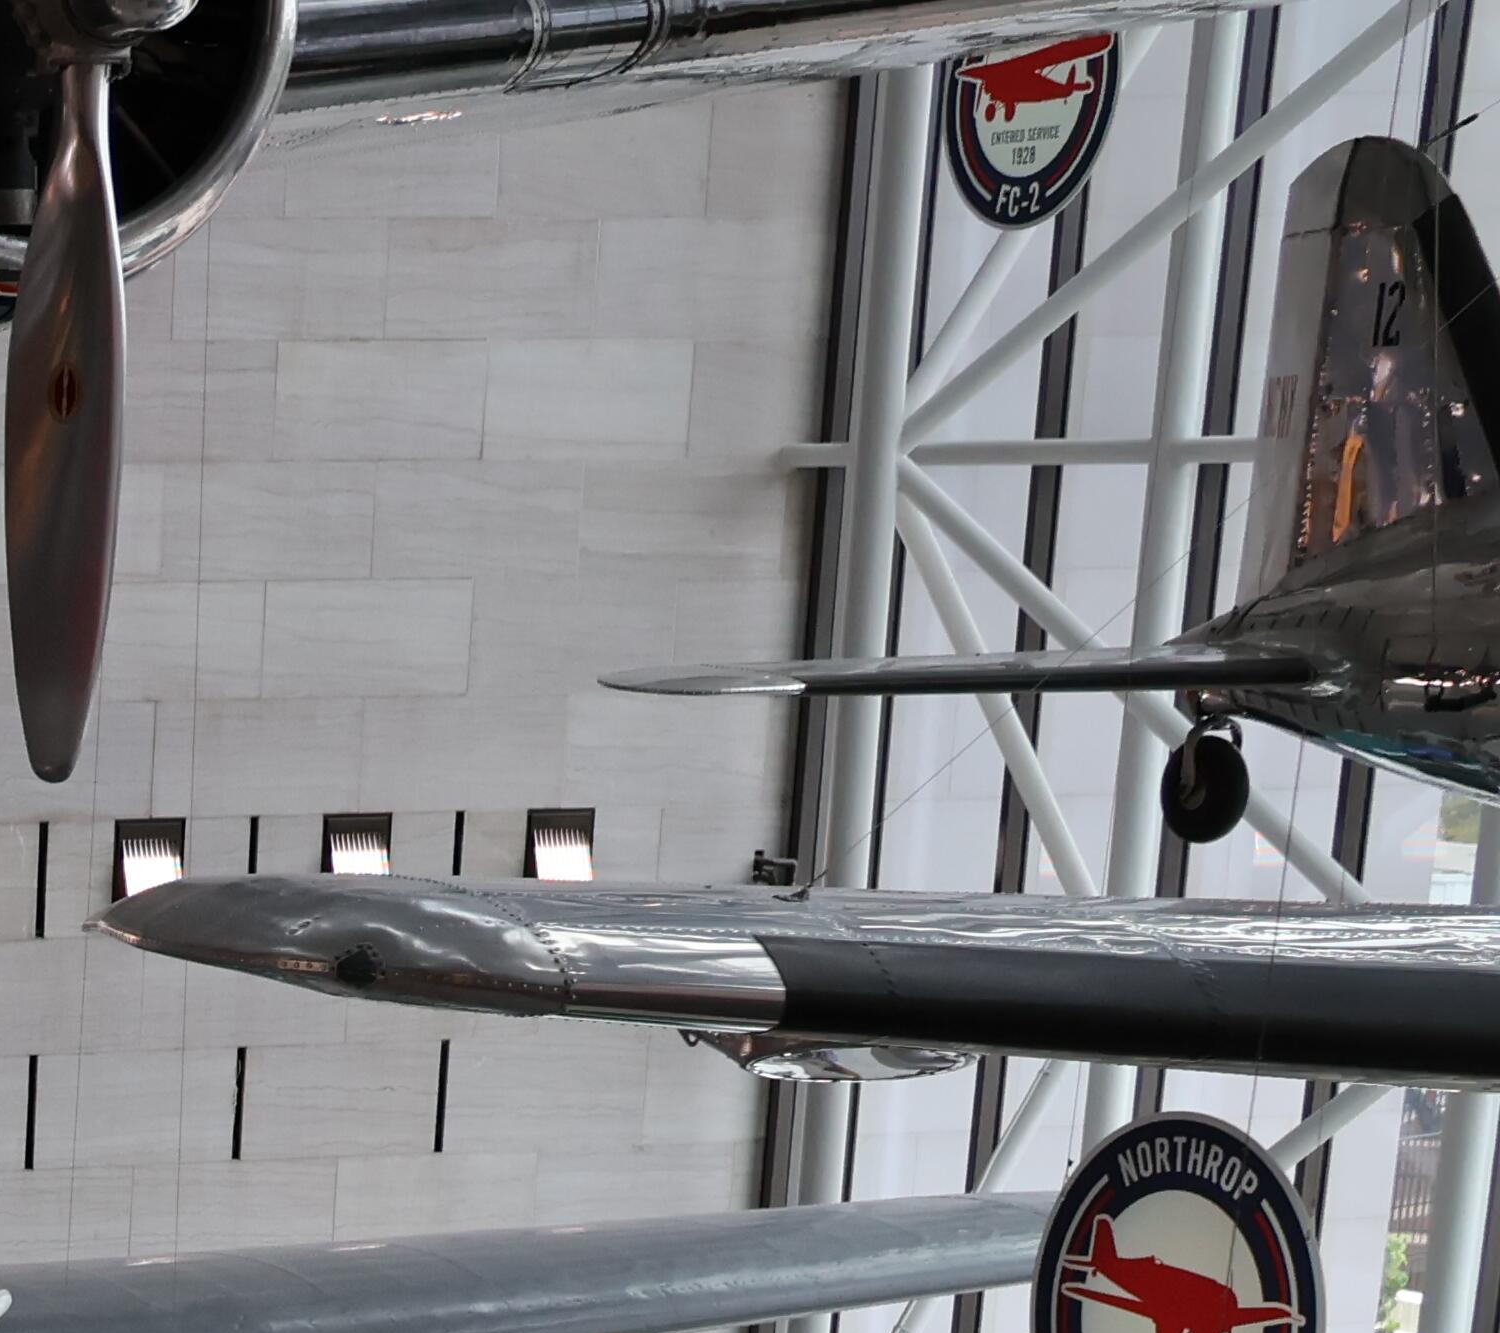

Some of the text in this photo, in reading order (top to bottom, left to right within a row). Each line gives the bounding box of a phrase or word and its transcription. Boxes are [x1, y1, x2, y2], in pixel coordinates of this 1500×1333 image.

[990, 125, 1060, 147] ENTERED SERVICE
[1011, 146, 1037, 165] 1928
[994, 184, 1042, 216] FC-2
[1373, 280, 1405, 348] 12
[1117, 1135, 1260, 1201] NORTHROP
